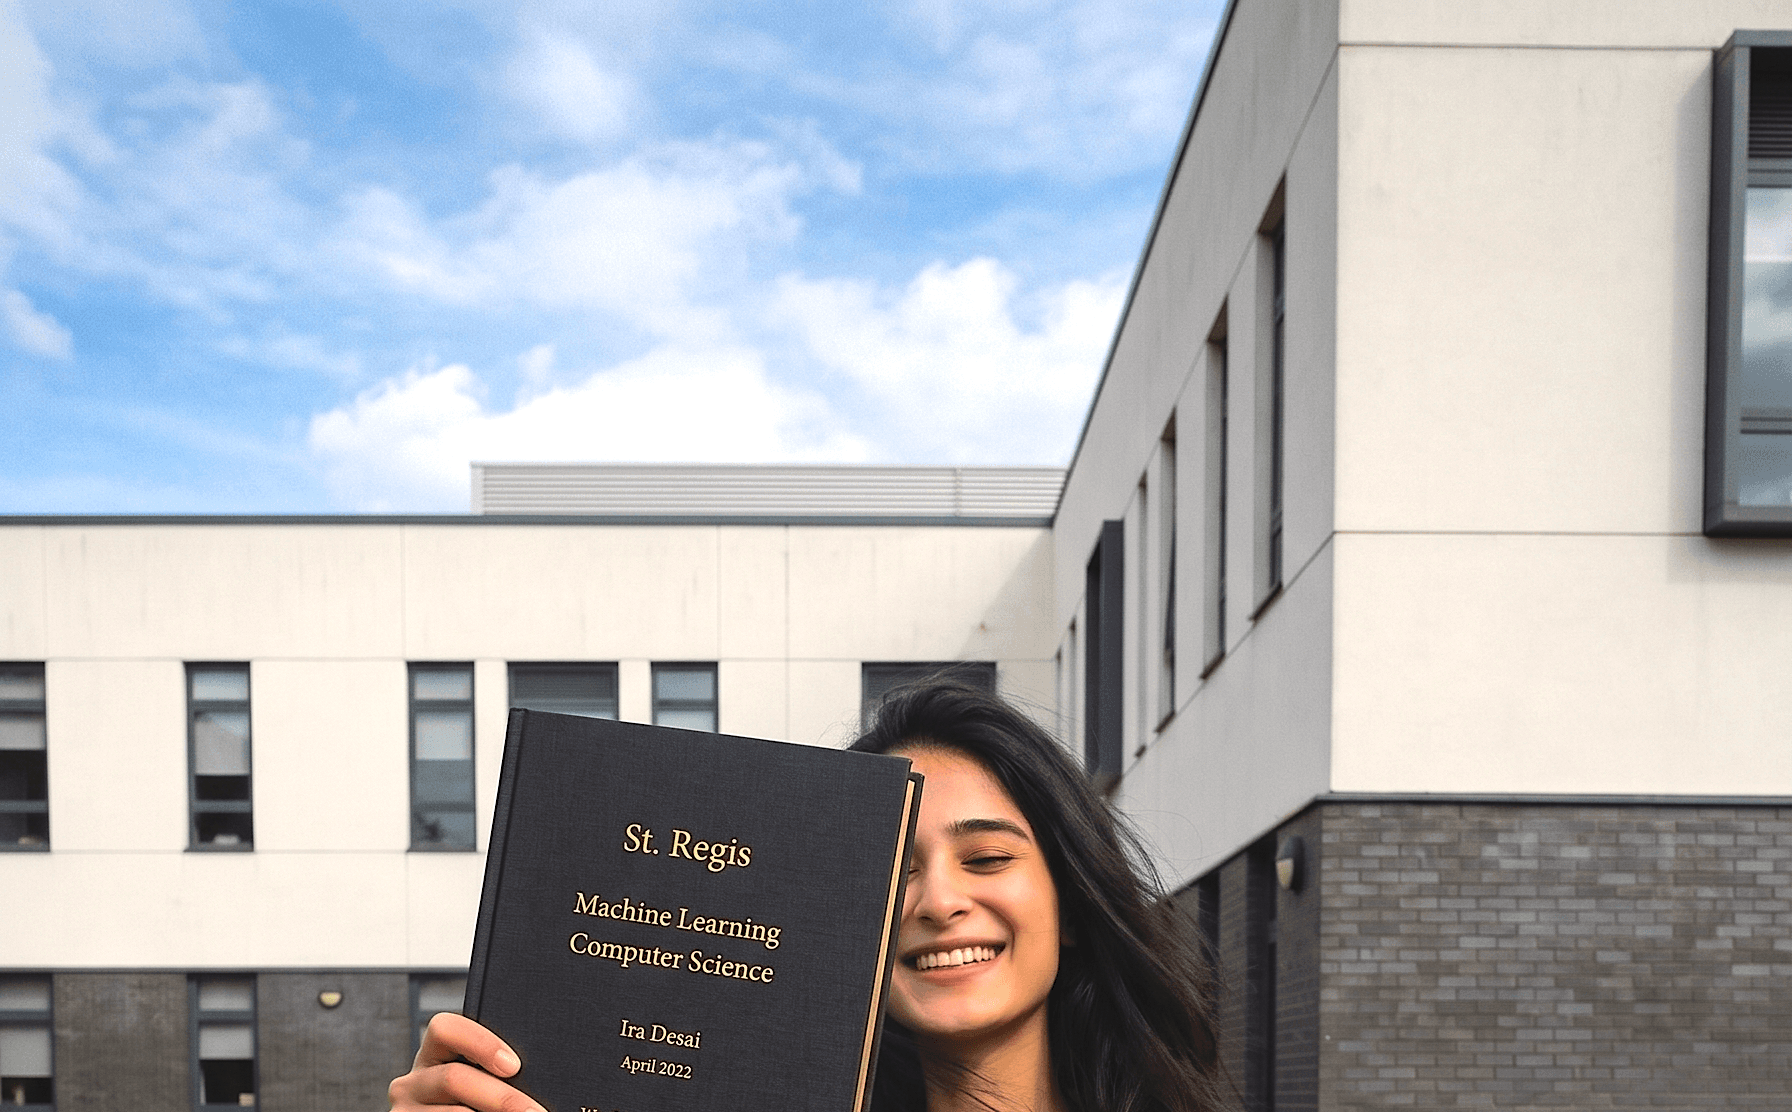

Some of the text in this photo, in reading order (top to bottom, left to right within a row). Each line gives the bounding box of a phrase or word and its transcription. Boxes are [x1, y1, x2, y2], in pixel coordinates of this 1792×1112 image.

[623, 823, 752, 873] St. Regis
[573, 892, 782, 950] Machine Learning
[569, 932, 774, 983] Computer Science
[619, 1019, 701, 1049] Ira Desai
[620, 1055, 692, 1079] April 2022
